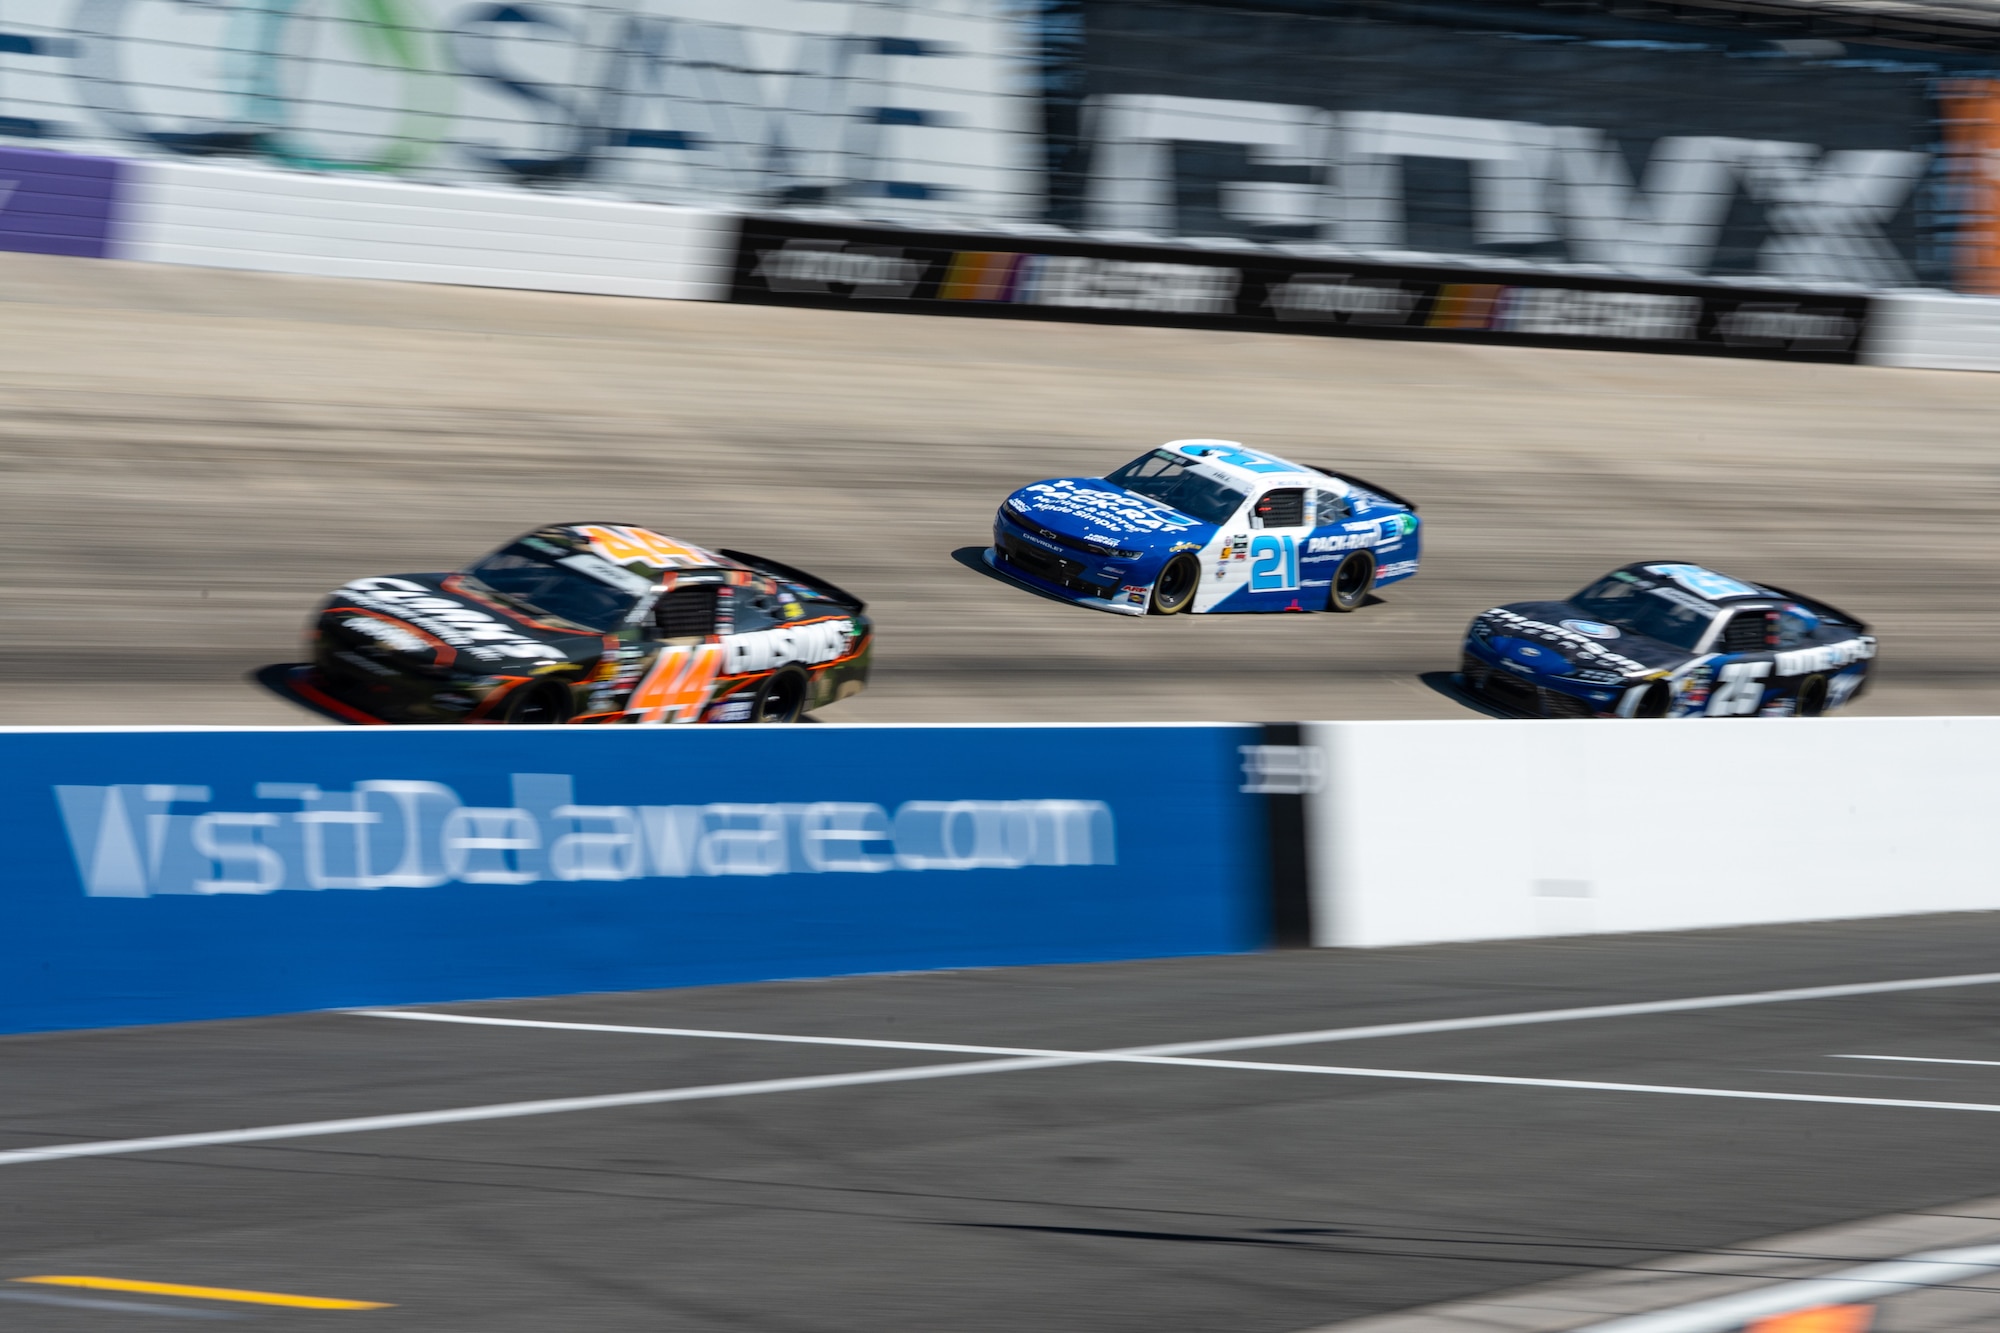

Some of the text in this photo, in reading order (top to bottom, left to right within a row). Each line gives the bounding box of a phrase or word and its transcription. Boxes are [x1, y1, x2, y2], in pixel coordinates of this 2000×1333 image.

[1032, 502, 1073, 514] Made
[1072, 510, 1122, 532] Simple
[576, 525, 720, 568] 44
[1022, 532, 1064, 553] CHEVROLET
[1250, 535, 1298, 591] 21
[626, 645, 723, 723] 44
[1705, 661, 1774, 717] 25
